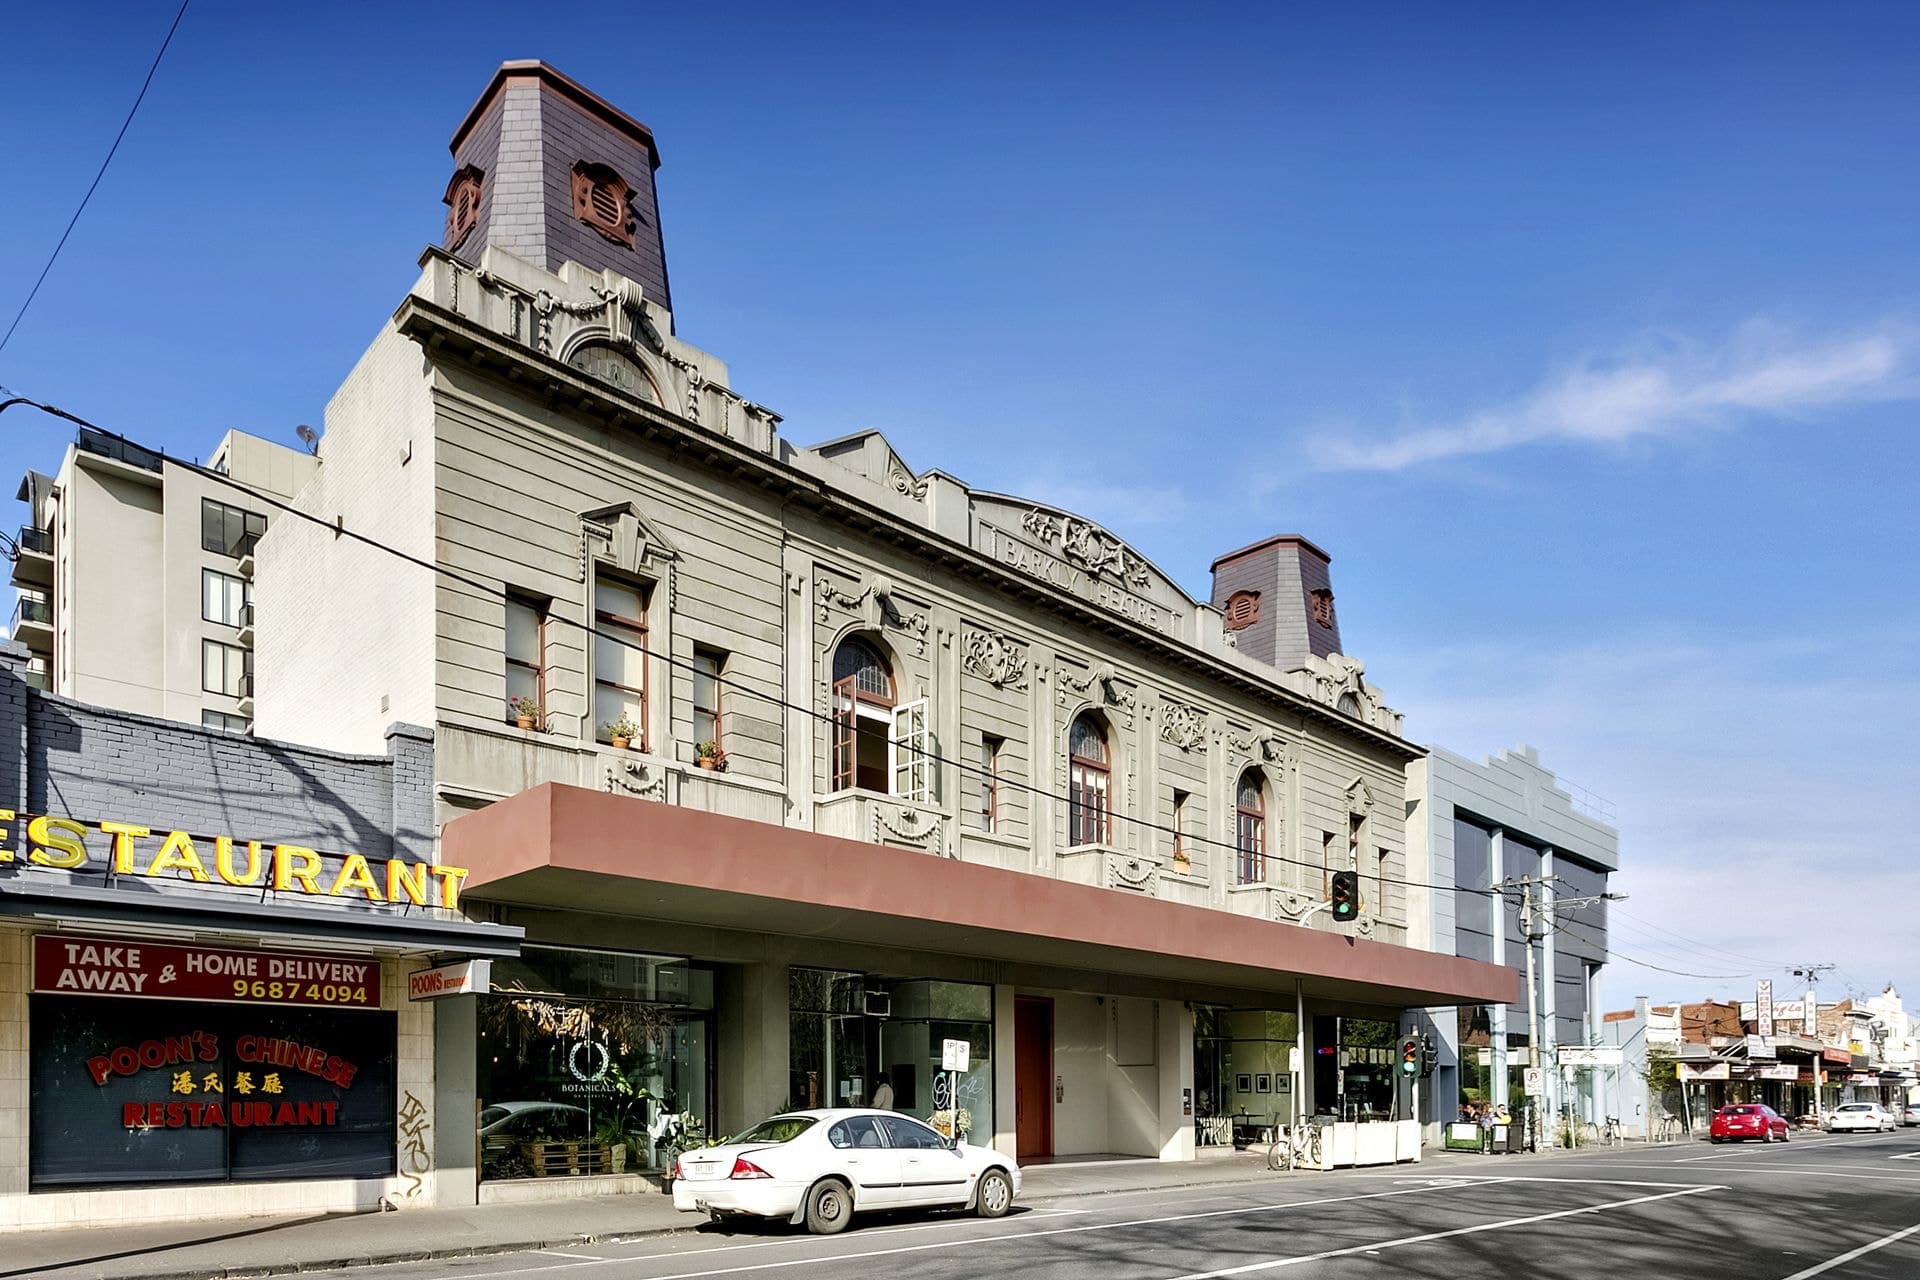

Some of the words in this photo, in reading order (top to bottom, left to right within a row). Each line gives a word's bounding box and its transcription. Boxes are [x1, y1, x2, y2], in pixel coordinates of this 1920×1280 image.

[1004, 541, 1080, 593] BARKLY
[64, 944, 141, 969] TAKE
[186, 952, 258, 977] HOME
[268, 958, 368, 983] DELIVERY
[56, 968, 149, 993] AWAY
[158, 964, 177, 984] &
[86, 1031, 219, 1085] POON'S
[236, 1035, 358, 1089] CHINESE
[561, 1084, 617, 1092] BOTANICALS
[122, 1101, 340, 1128] RESTAURANT
